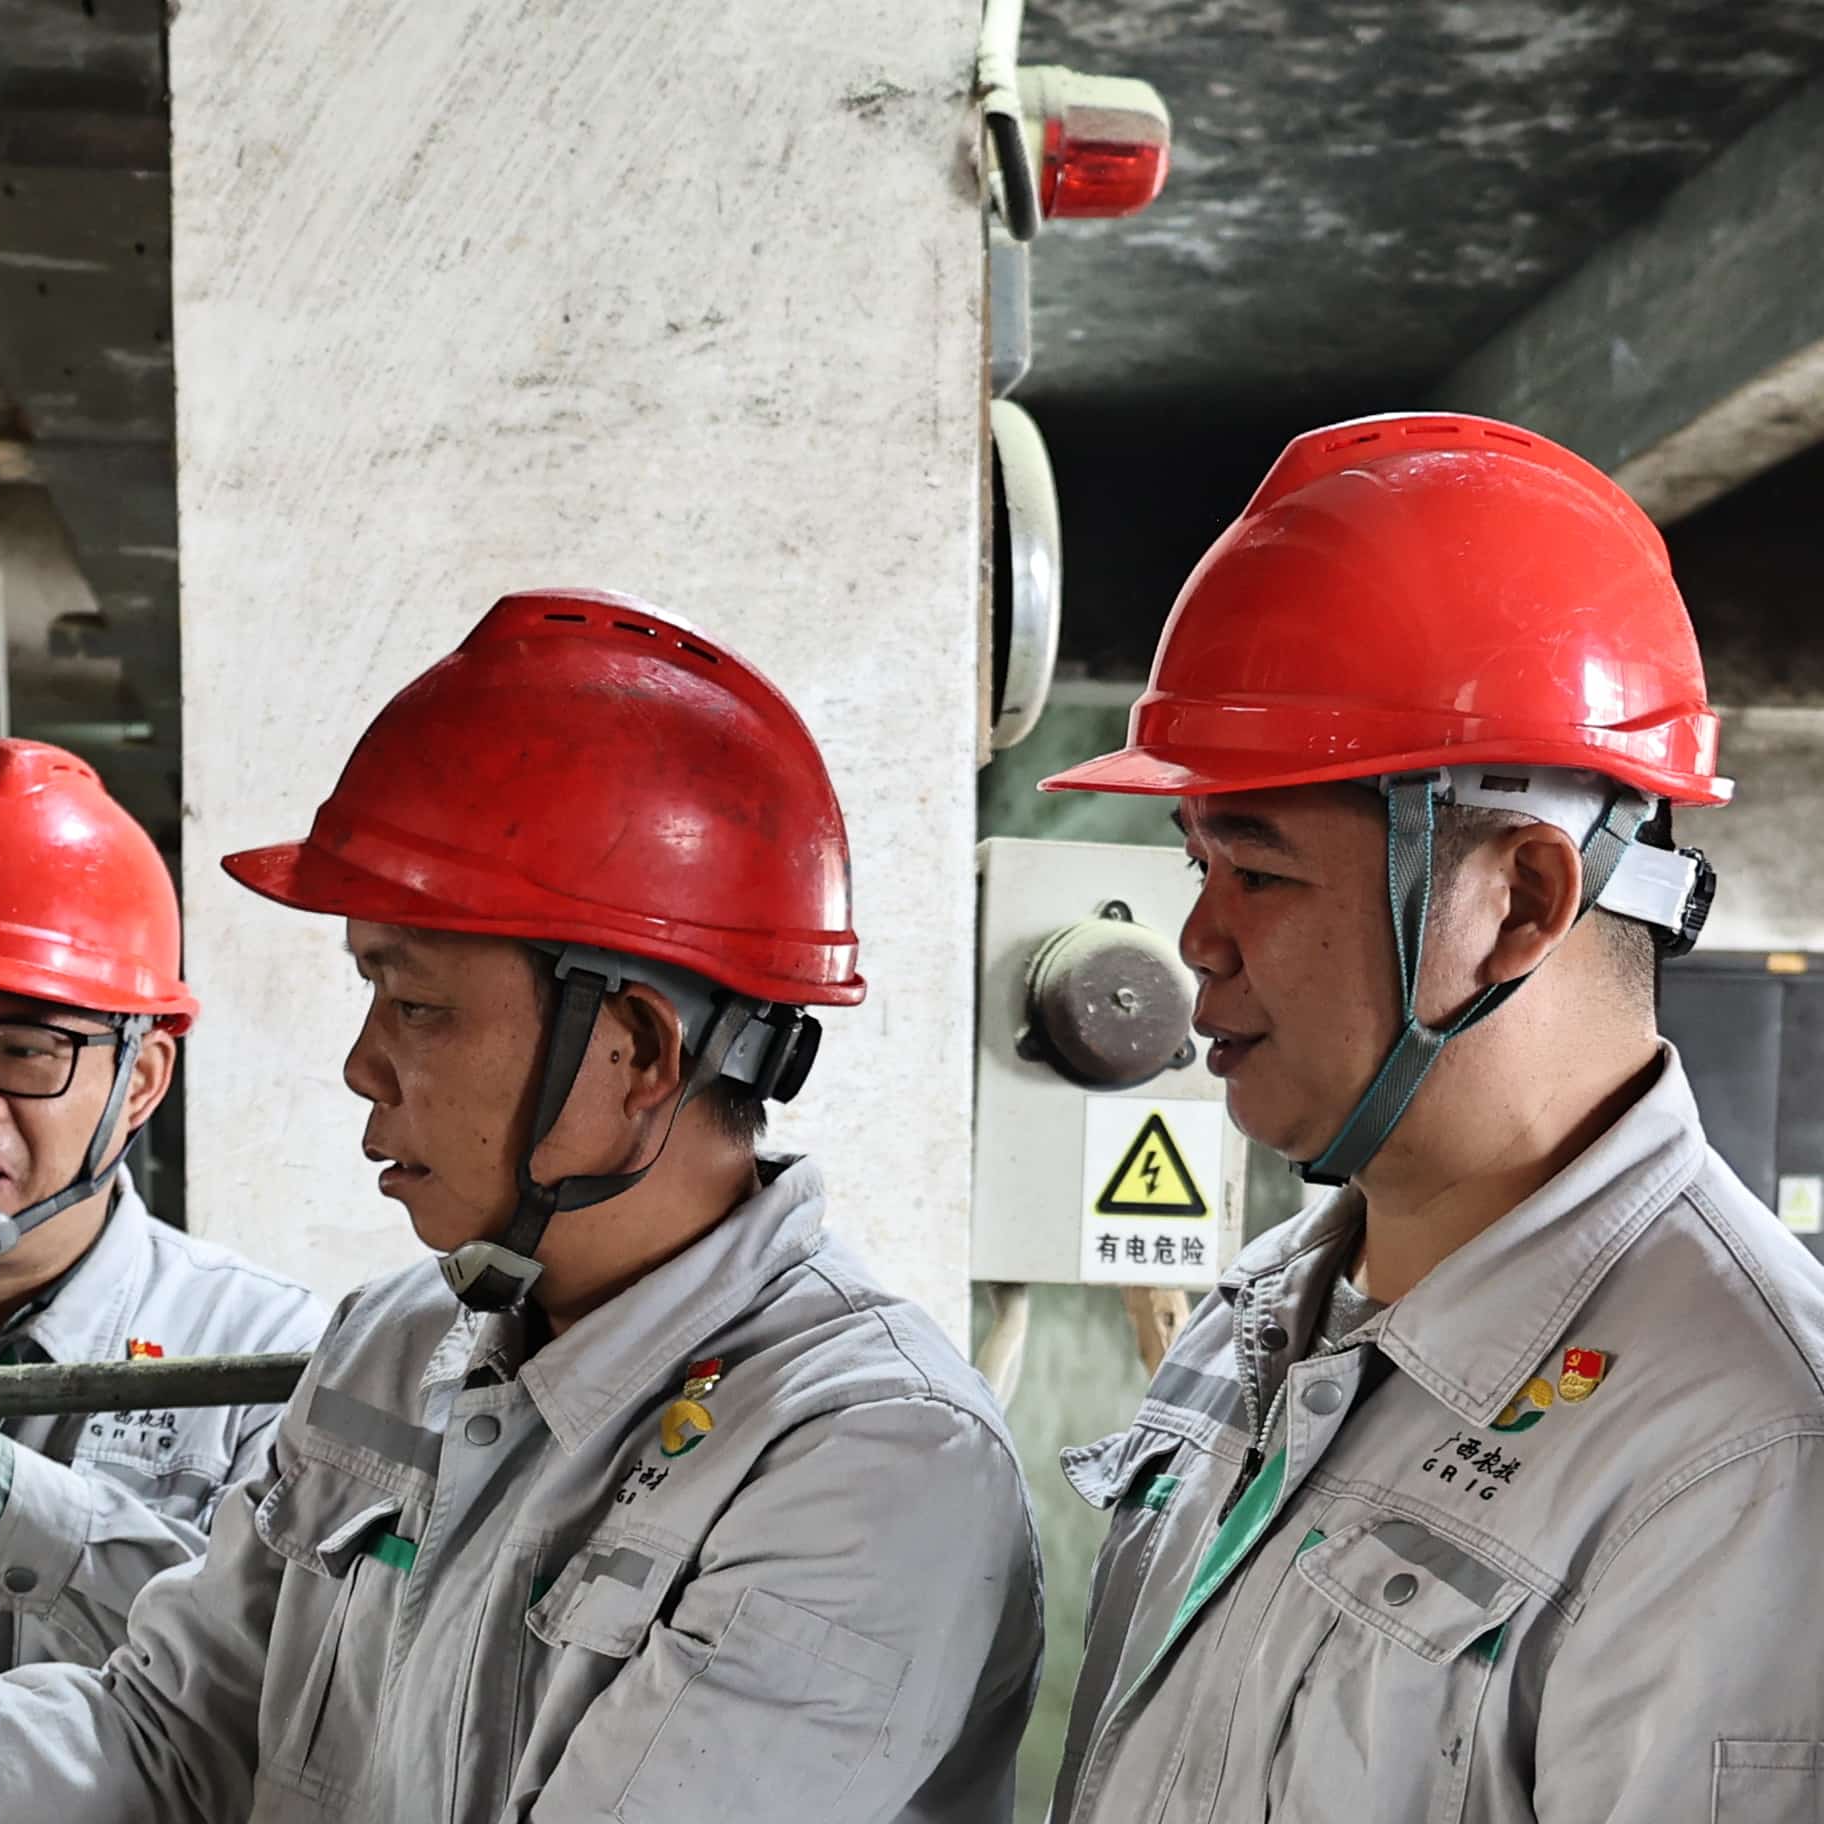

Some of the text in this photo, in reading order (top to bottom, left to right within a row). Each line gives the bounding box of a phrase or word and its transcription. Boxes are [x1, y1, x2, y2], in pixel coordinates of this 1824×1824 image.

[1095, 1232, 1206, 1266] 有电危险
[1421, 1457, 1498, 1501] GRIG
[1432, 1431, 1522, 1485] 广西农投
